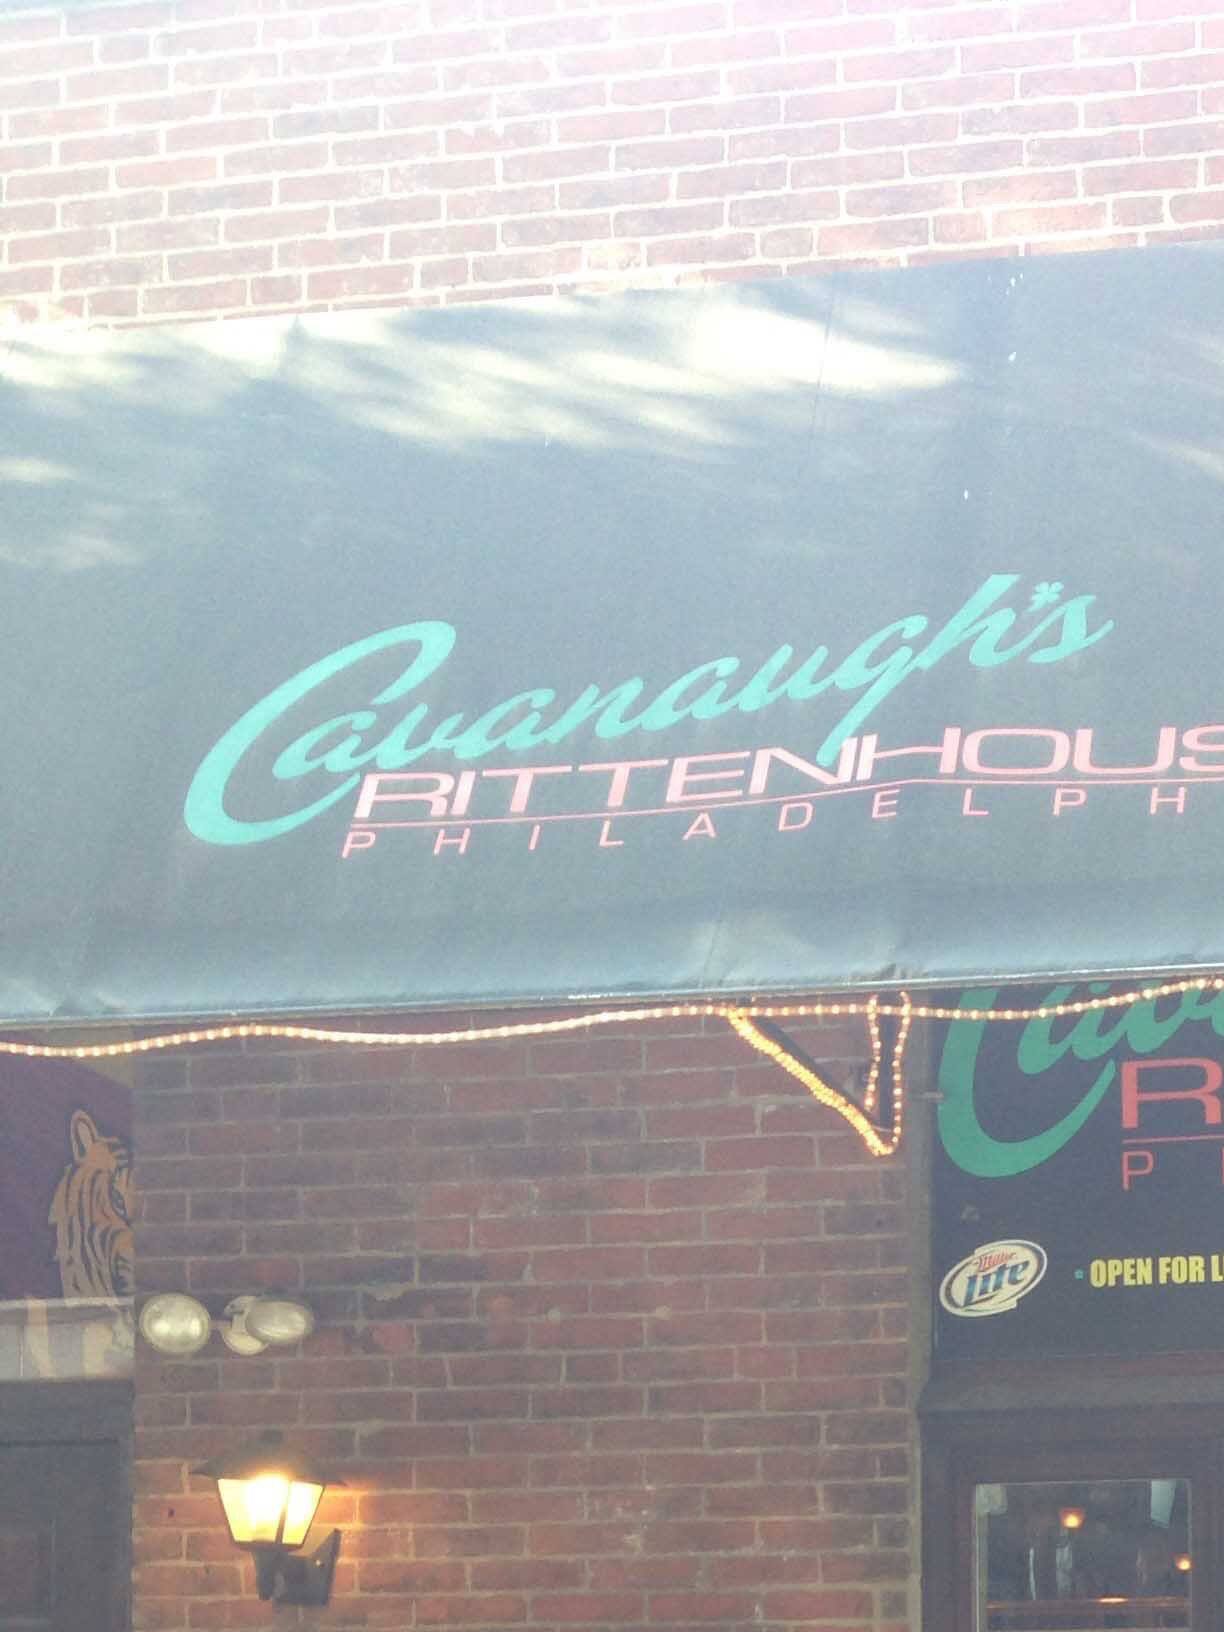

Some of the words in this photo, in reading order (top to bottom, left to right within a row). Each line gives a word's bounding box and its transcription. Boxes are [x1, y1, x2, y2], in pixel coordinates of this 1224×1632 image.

[184, 574, 1113, 845] Cavanaugh's
[962, 1260, 1029, 1306] Lite
[1090, 1257, 1153, 1288] OPEN
[1158, 1254, 1206, 1286] FOR
